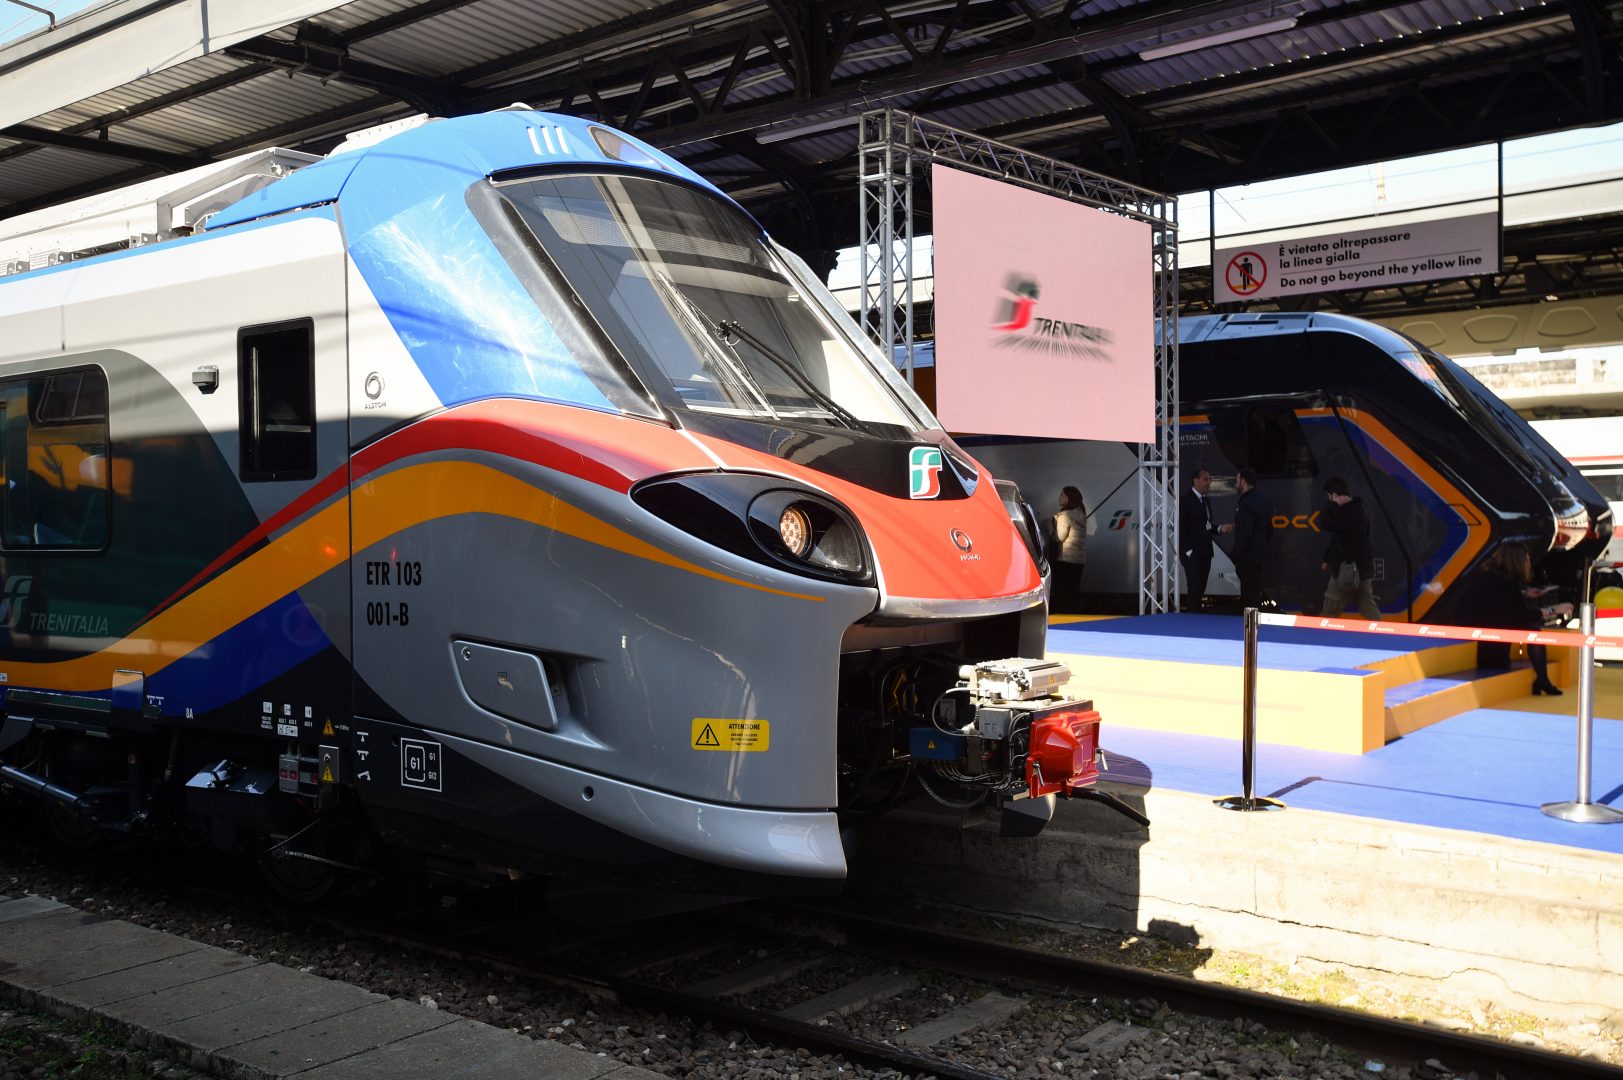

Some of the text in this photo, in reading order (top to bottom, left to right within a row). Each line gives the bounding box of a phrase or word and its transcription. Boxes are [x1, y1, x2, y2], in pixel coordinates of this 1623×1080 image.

[1279, 231, 1411, 257] È vietato oltrepassare
[1279, 250, 1360, 269] la linea gialla
[1280, 254, 1482, 288] Do not go beyond the yellow line
[366, 561, 422, 586] ETR 103
[30, 612, 109, 635] TRENITALIA
[367, 602, 409, 627] 001-B
[185, 707, 194, 720] 8A
[728, 723, 760, 731] ATTENZIONE
[410, 756, 420, 771] G1
